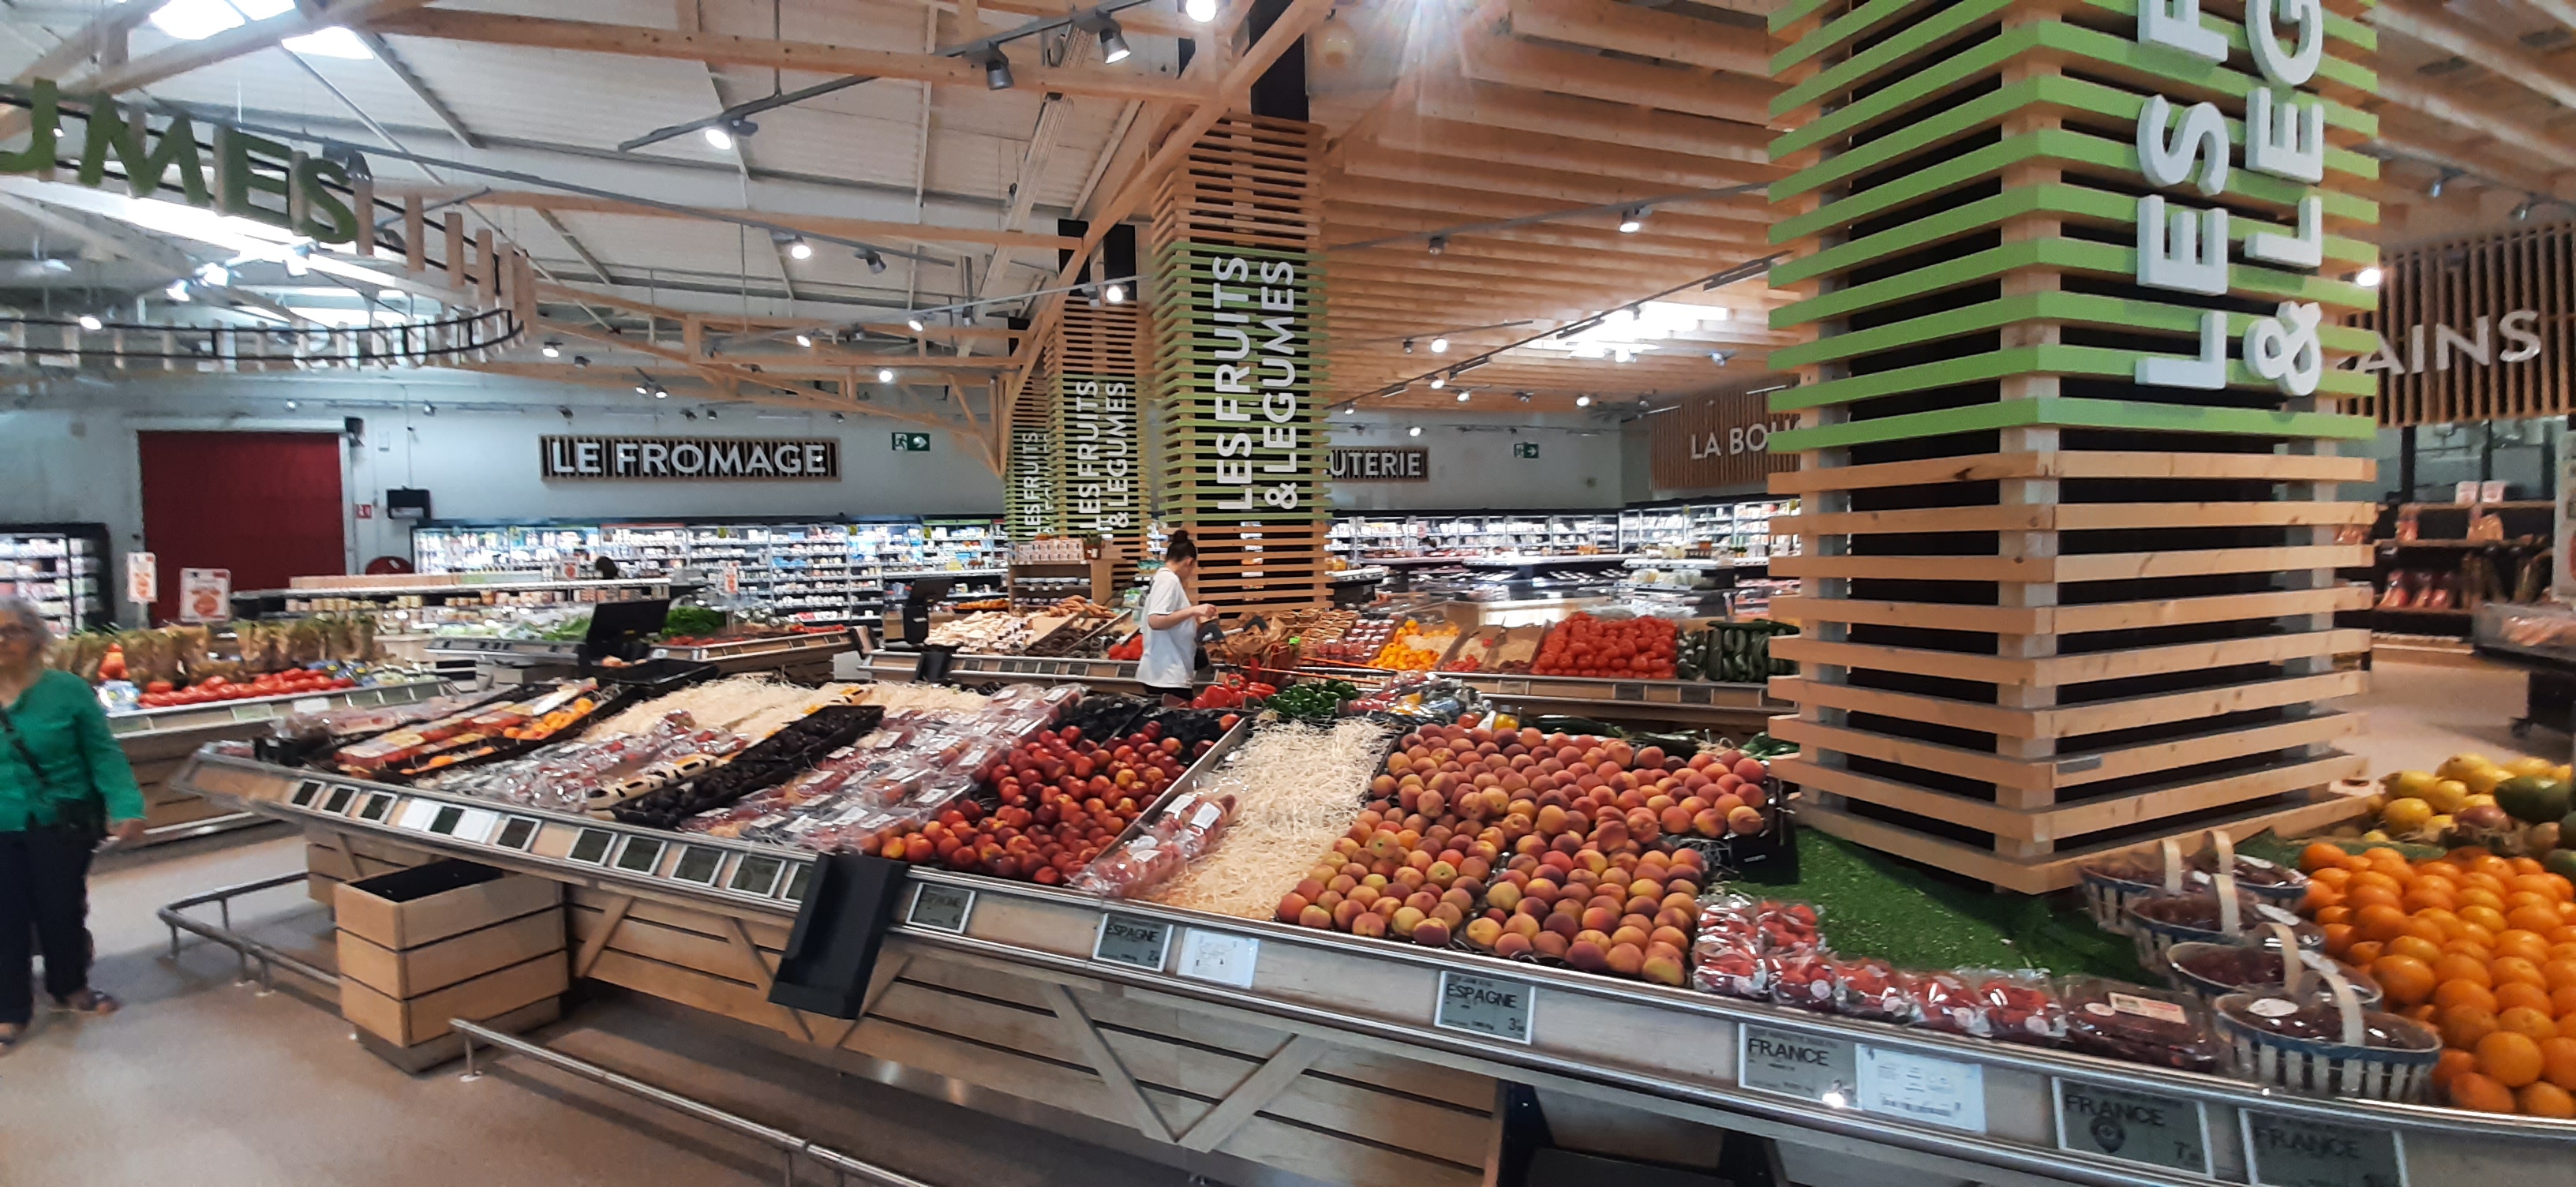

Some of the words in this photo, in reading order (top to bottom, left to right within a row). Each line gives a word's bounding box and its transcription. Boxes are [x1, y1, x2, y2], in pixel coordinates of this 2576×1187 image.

[2135, 93, 2230, 390] LES
[1212, 256, 1252, 421] FRUITS
[1260, 261, 1297, 472] LEGUMES
[2243, 301, 2322, 396] &
[1076, 381, 1100, 477] FRUITS
[1105, 382, 1129, 507] LEGUMES
[1690, 432, 1722, 459] LA
[552, 441, 601, 474] LE
[616, 444, 826, 474] FROMAGE
[1022, 432, 1040, 500] FRUITS
[1216, 433, 1253, 509] LES
[1324, 451, 1421, 477] UTERIE
[1078, 483, 1101, 528] LES
[1264, 482, 1298, 510] &
[1445, 983, 1517, 1009] ESPAGNE
[1747, 1038, 1829, 1066] FRANCE
[2065, 1095, 2166, 1127] FRANCE
